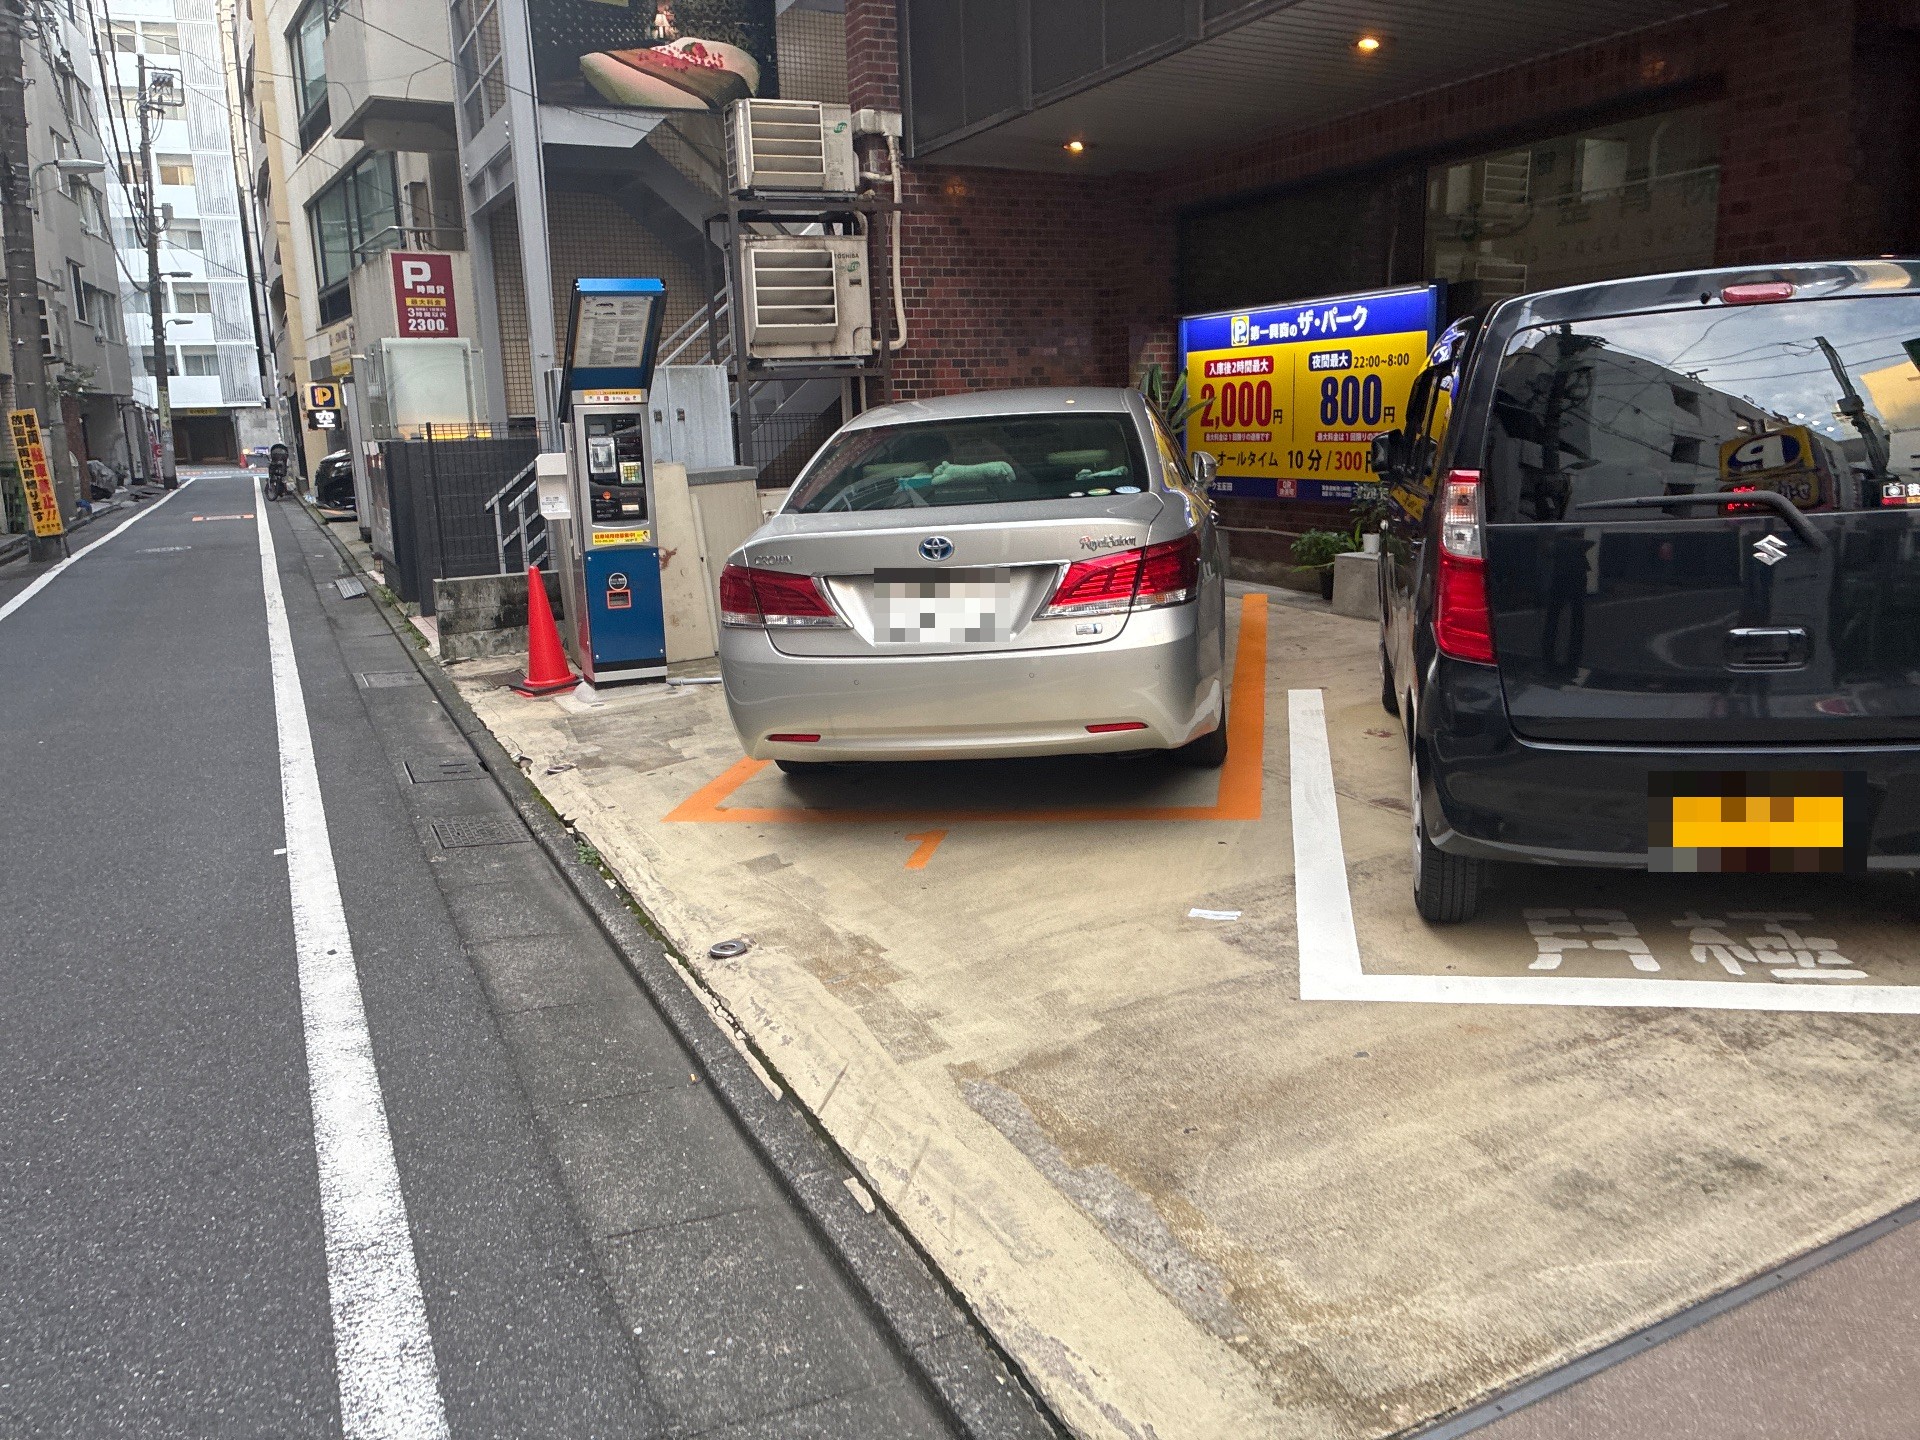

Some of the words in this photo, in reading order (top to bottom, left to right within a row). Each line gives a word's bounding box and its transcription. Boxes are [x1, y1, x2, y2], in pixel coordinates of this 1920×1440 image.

[402, 261, 431, 289] P
[408, 318, 445, 331] 2300
[1209, 358, 1269, 375] 入庫後2時間最大
[1312, 352, 1348, 369] 夜間最大
[314, 387, 331, 405] P
[1200, 380, 1283, 429] 2,000円
[1320, 374, 1395, 426] 800円
[315, 410, 336, 428] 空
[1217, 451, 1278, 467] オールタイム
[754, 555, 792, 565] CROWN
[1521, 907, 1870, 980] 月極
